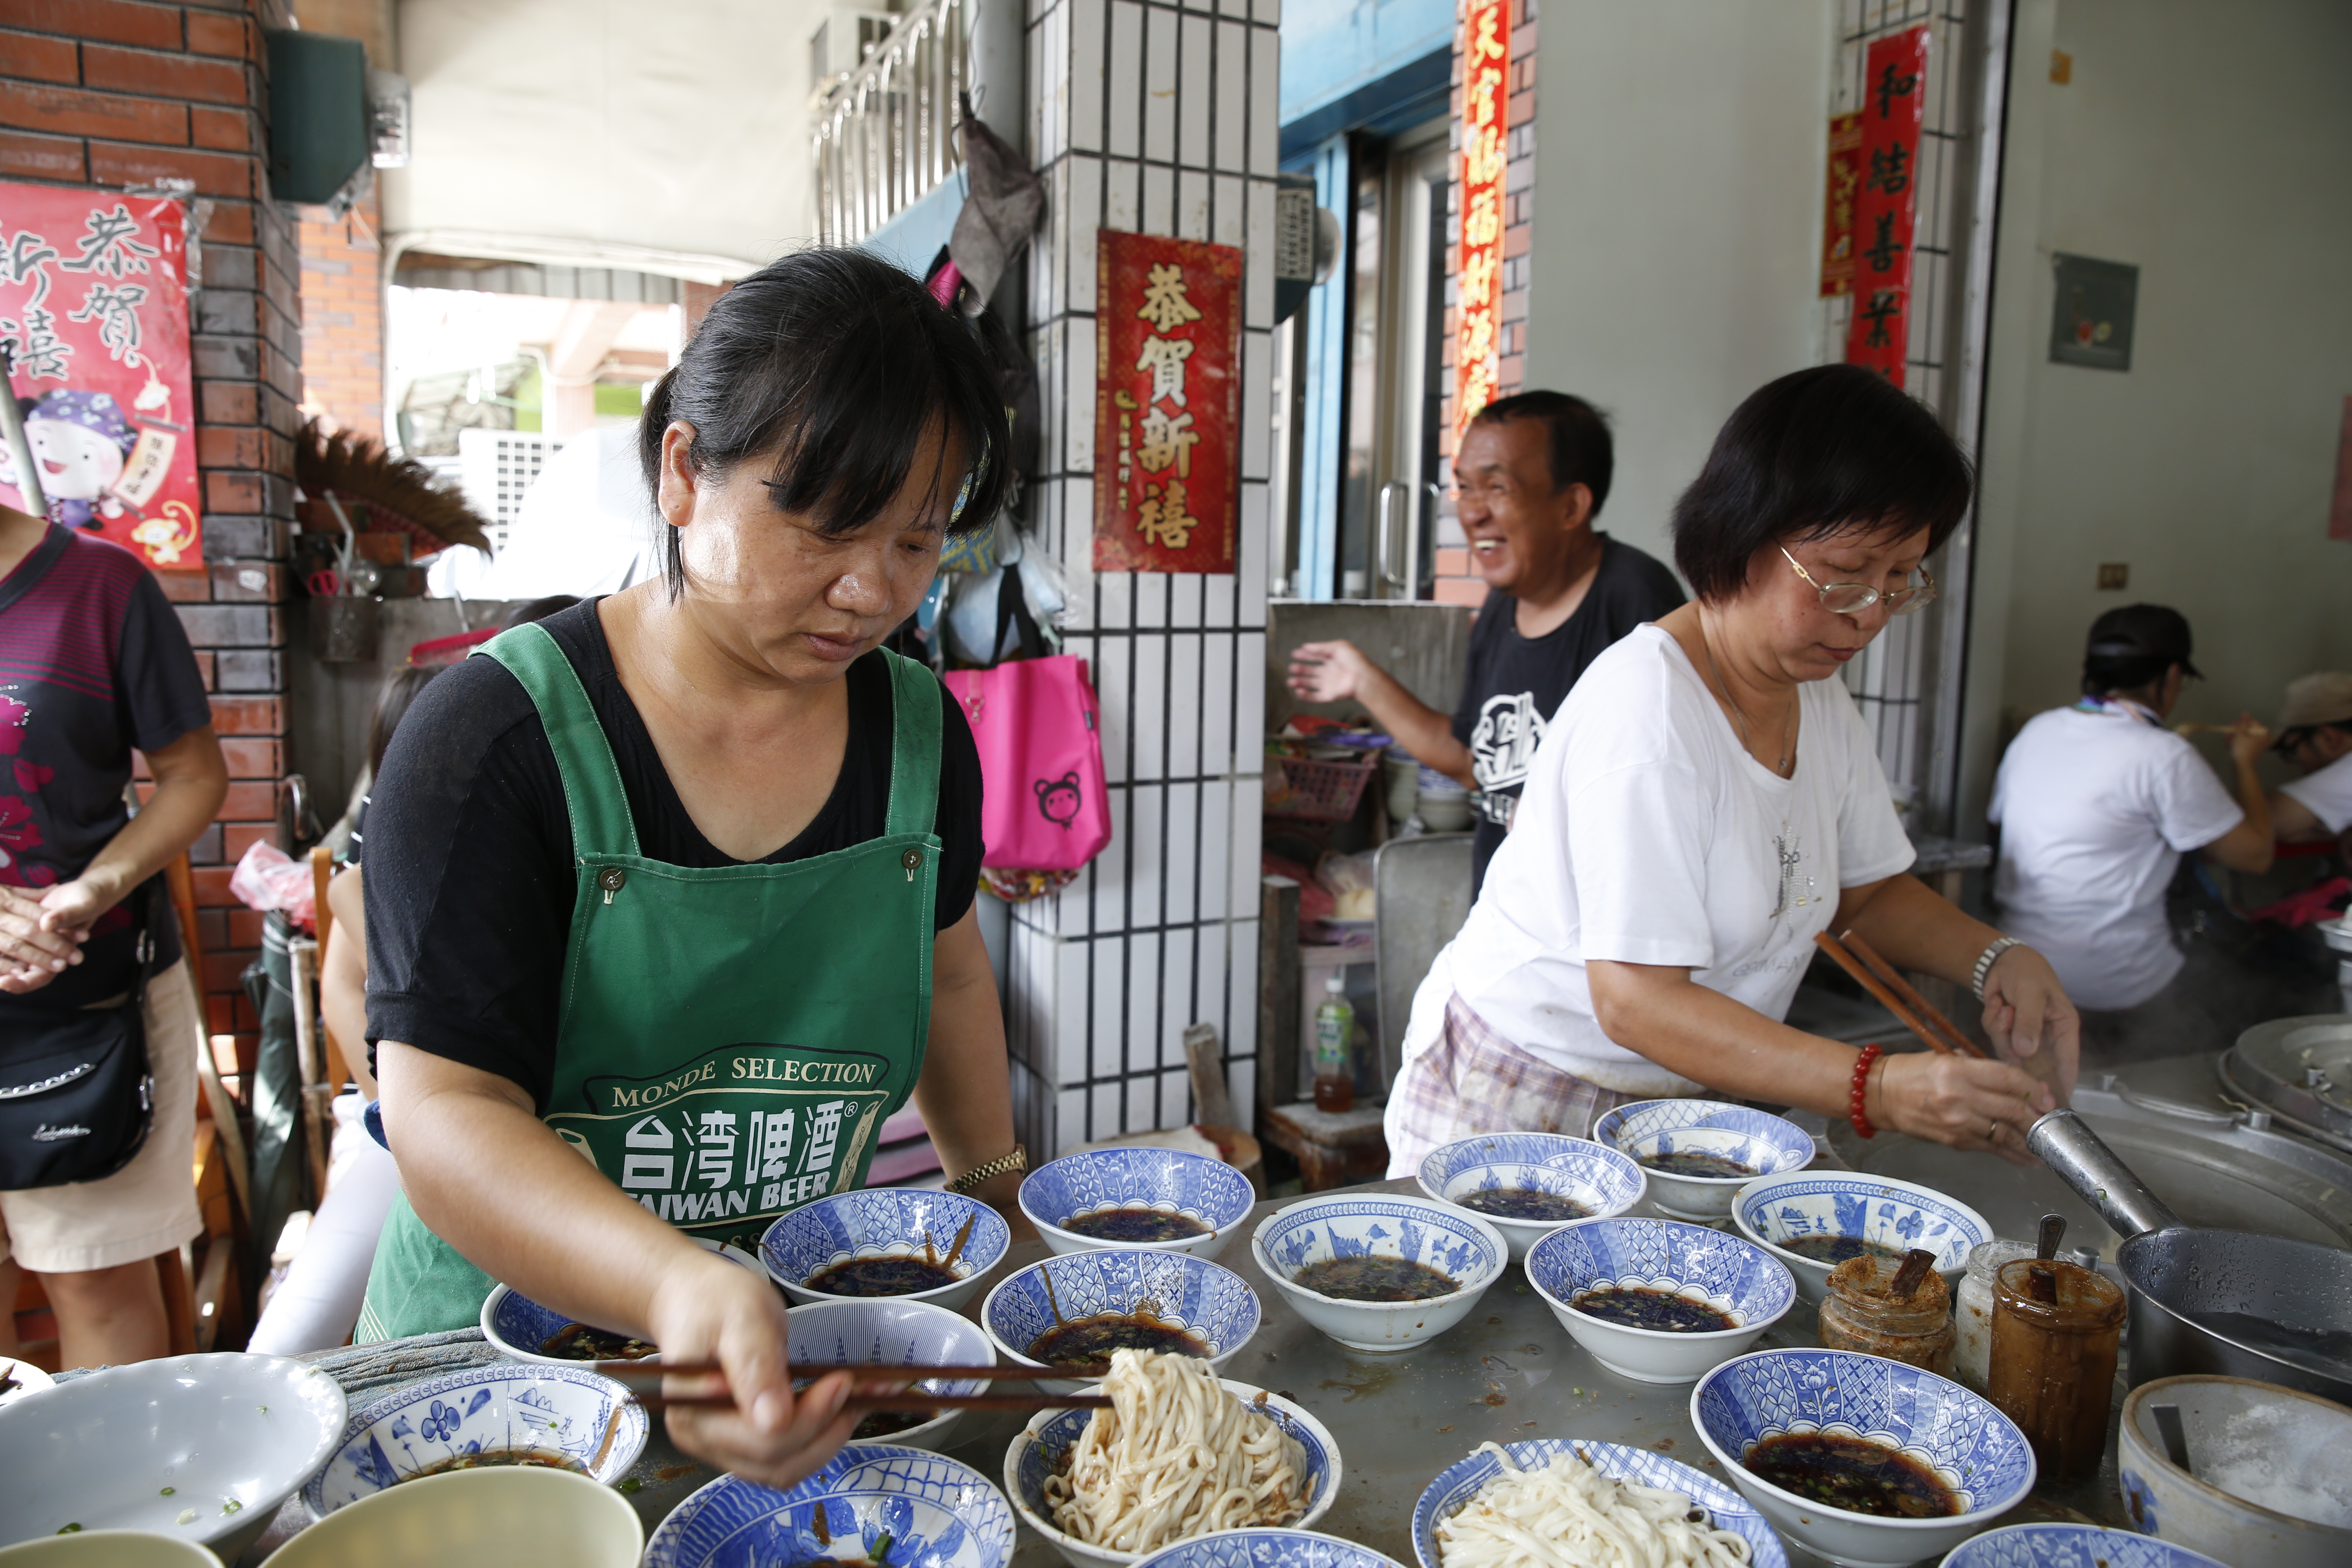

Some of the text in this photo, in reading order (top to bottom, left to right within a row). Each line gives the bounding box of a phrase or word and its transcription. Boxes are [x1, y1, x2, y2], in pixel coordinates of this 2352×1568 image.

[60, 204, 160, 367] 恭賀
[1135, 262, 1203, 549] 恭賀新禧
[612, 1057, 876, 1107] MONDE SELECTION
[625, 1171, 830, 1220] AIWAN BEER
